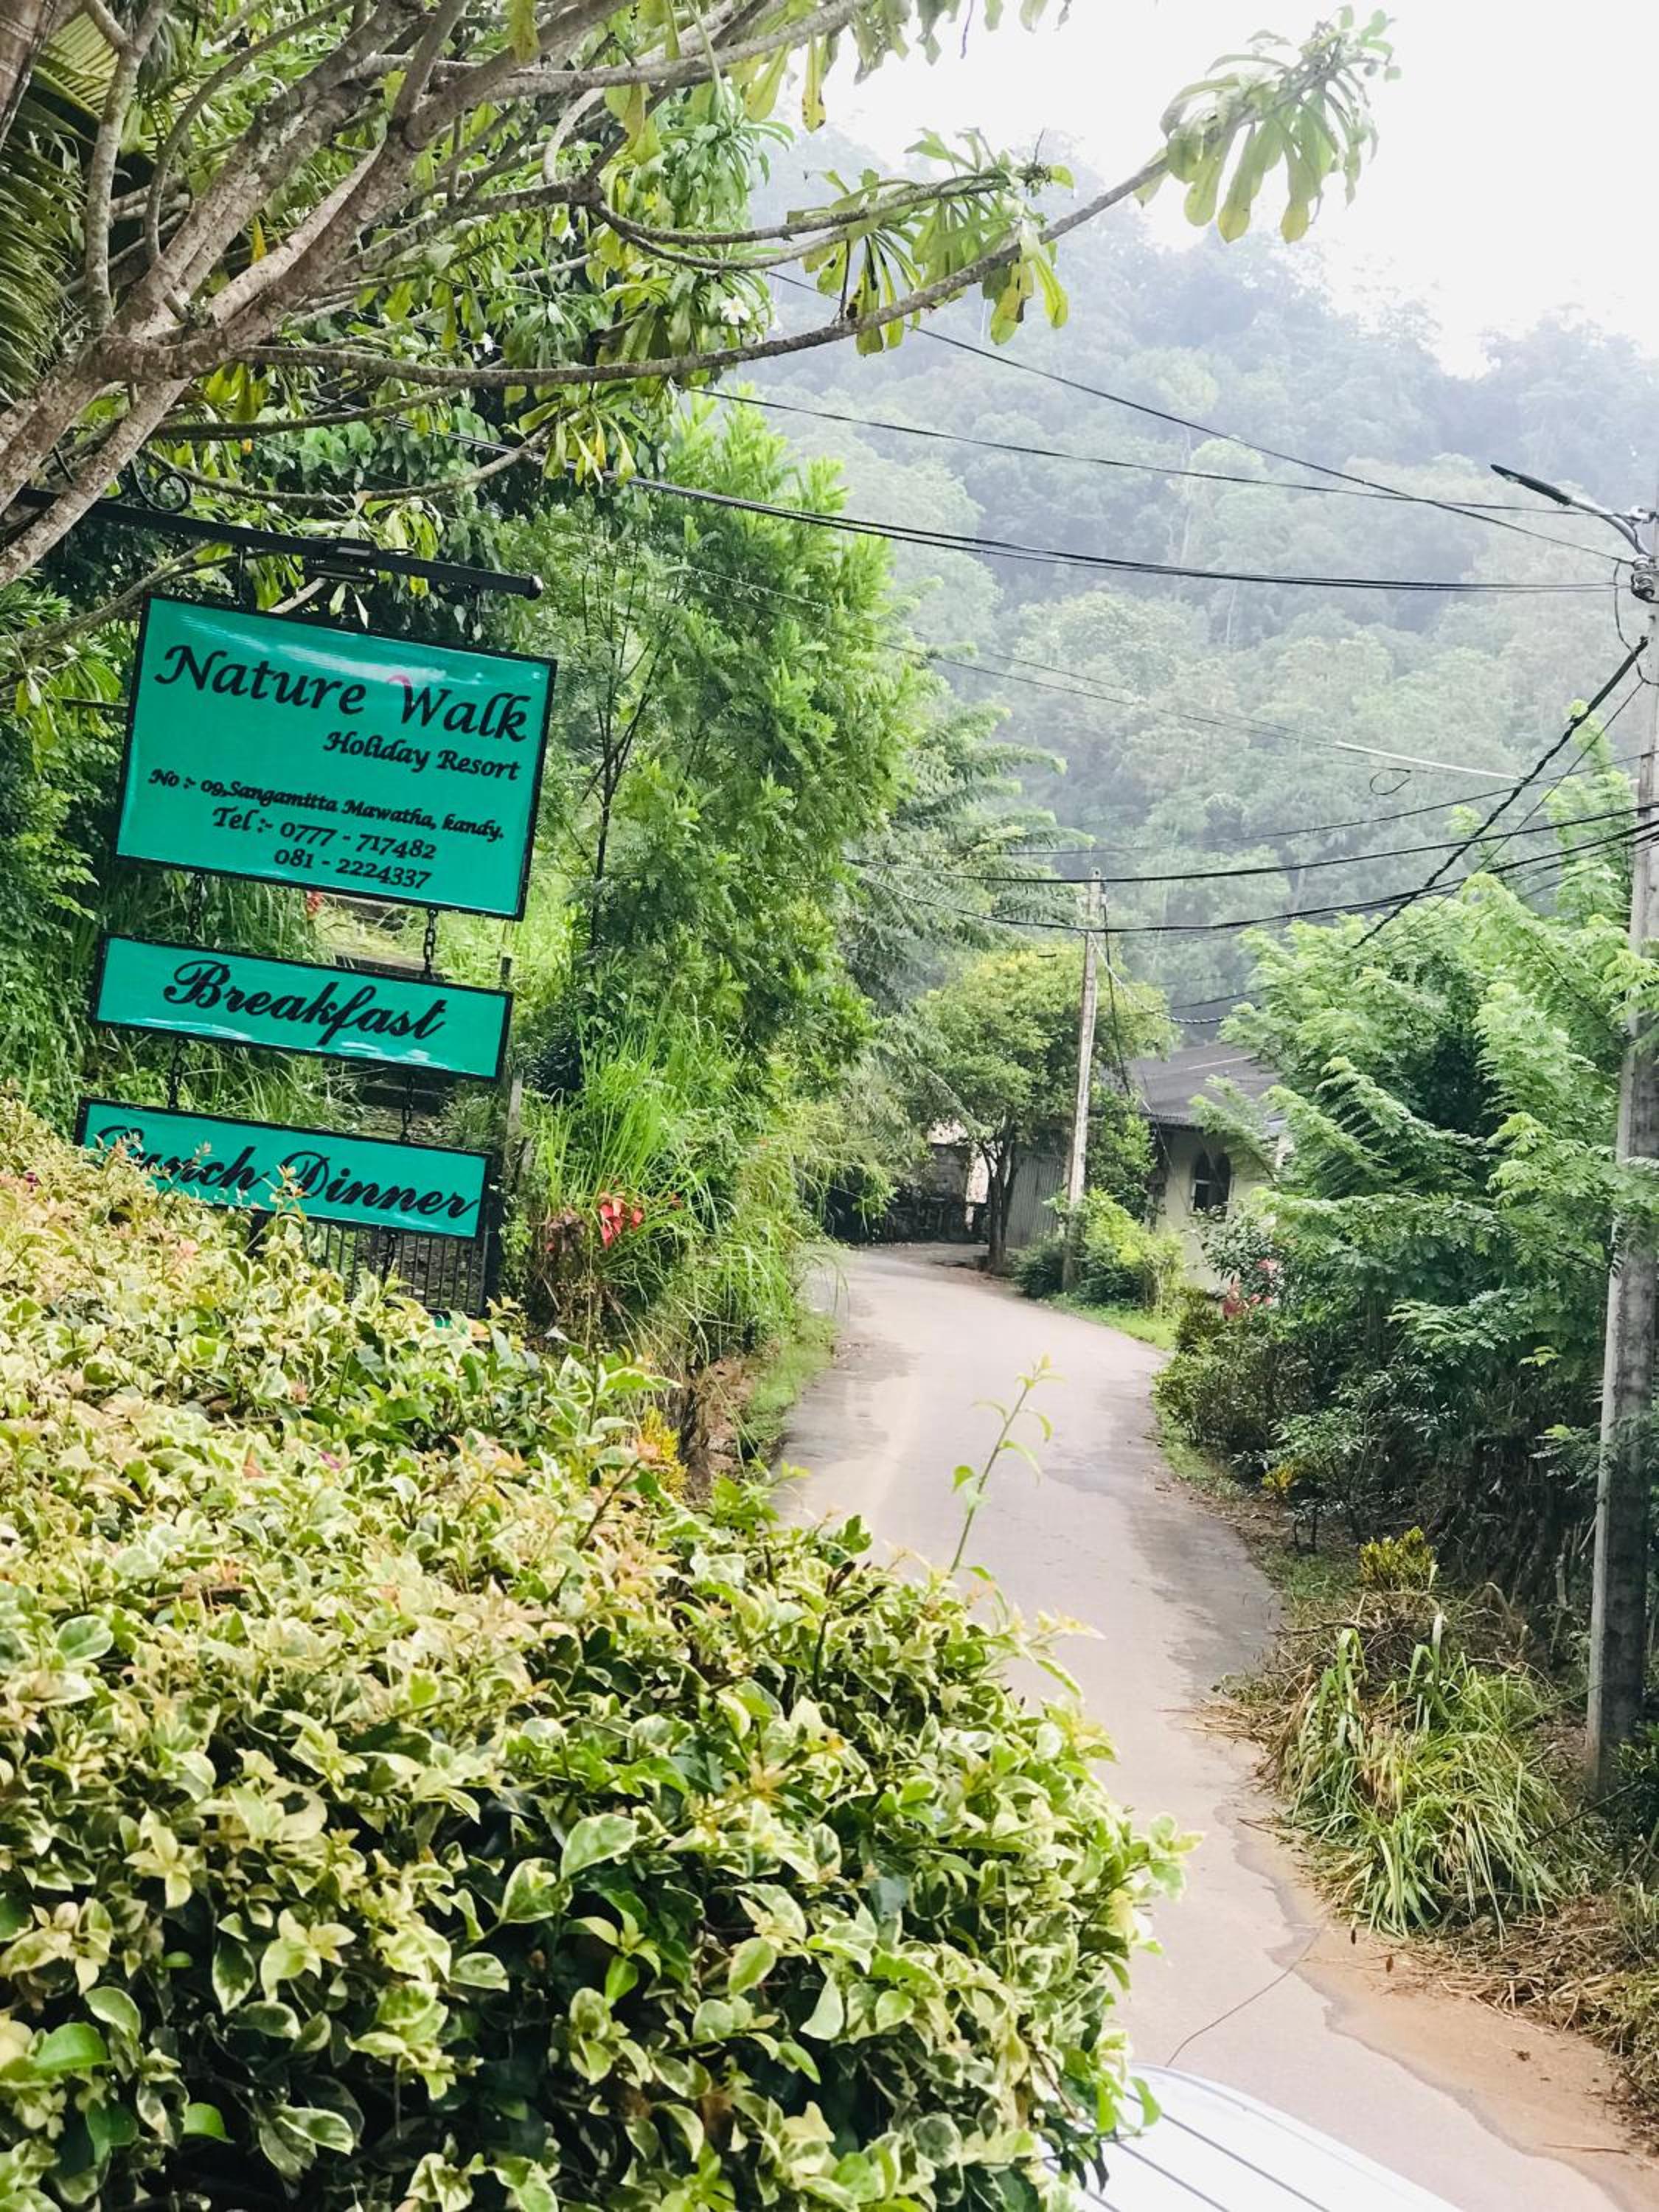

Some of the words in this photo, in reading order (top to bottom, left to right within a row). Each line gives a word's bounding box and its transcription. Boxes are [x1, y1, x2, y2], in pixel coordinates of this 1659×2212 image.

[154, 645, 366, 715] Nature
[387, 674, 532, 742] Walk
[323, 731, 431, 773] Holiday
[437, 749, 521, 780] Resort
[148, 768, 180, 787] No
[341, 799, 437, 830] Mawatha,
[212, 806, 260, 831] Tel
[279, 822, 338, 846] 0777
[355, 834, 437, 860] 717482
[274, 849, 314, 869] 081
[335, 858, 433, 889] 2224337
[163, 960, 446, 1046] Breakfast
[278, 1151, 479, 1218] Dinner
